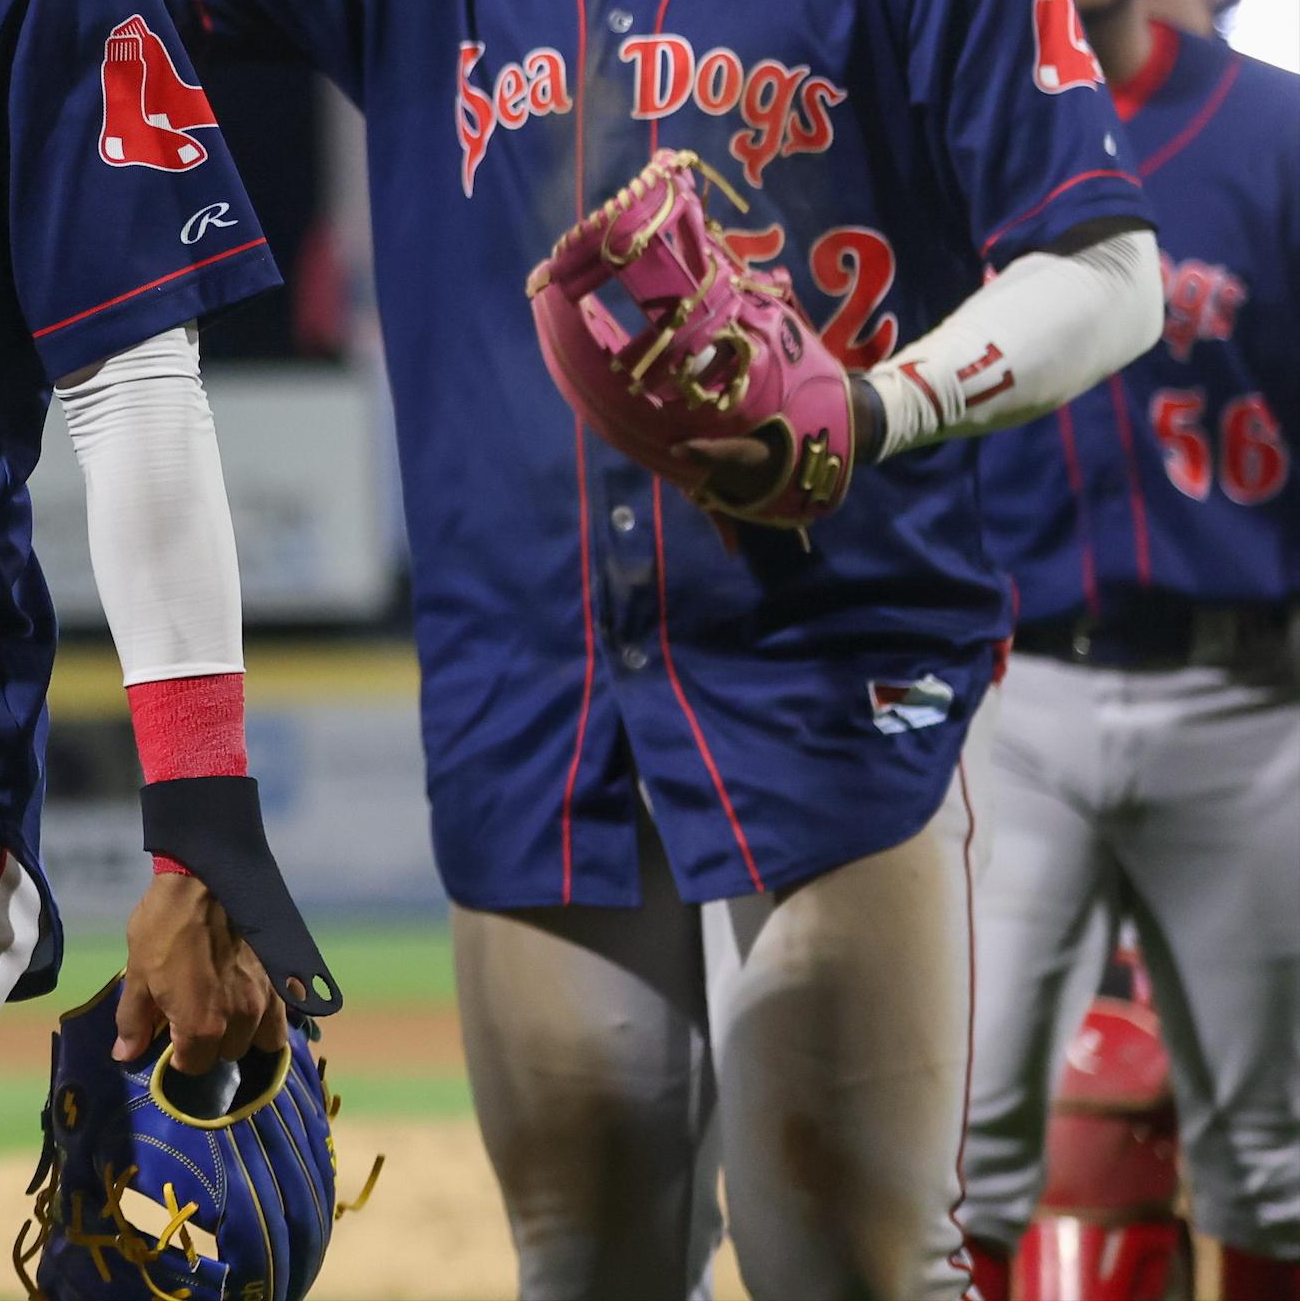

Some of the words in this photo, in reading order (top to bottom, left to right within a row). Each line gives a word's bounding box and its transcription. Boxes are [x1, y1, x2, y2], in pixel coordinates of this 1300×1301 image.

[456, 40, 573, 199] Sea
[618, 33, 848, 189] Dogs
[1150, 388, 1290, 505] 56
